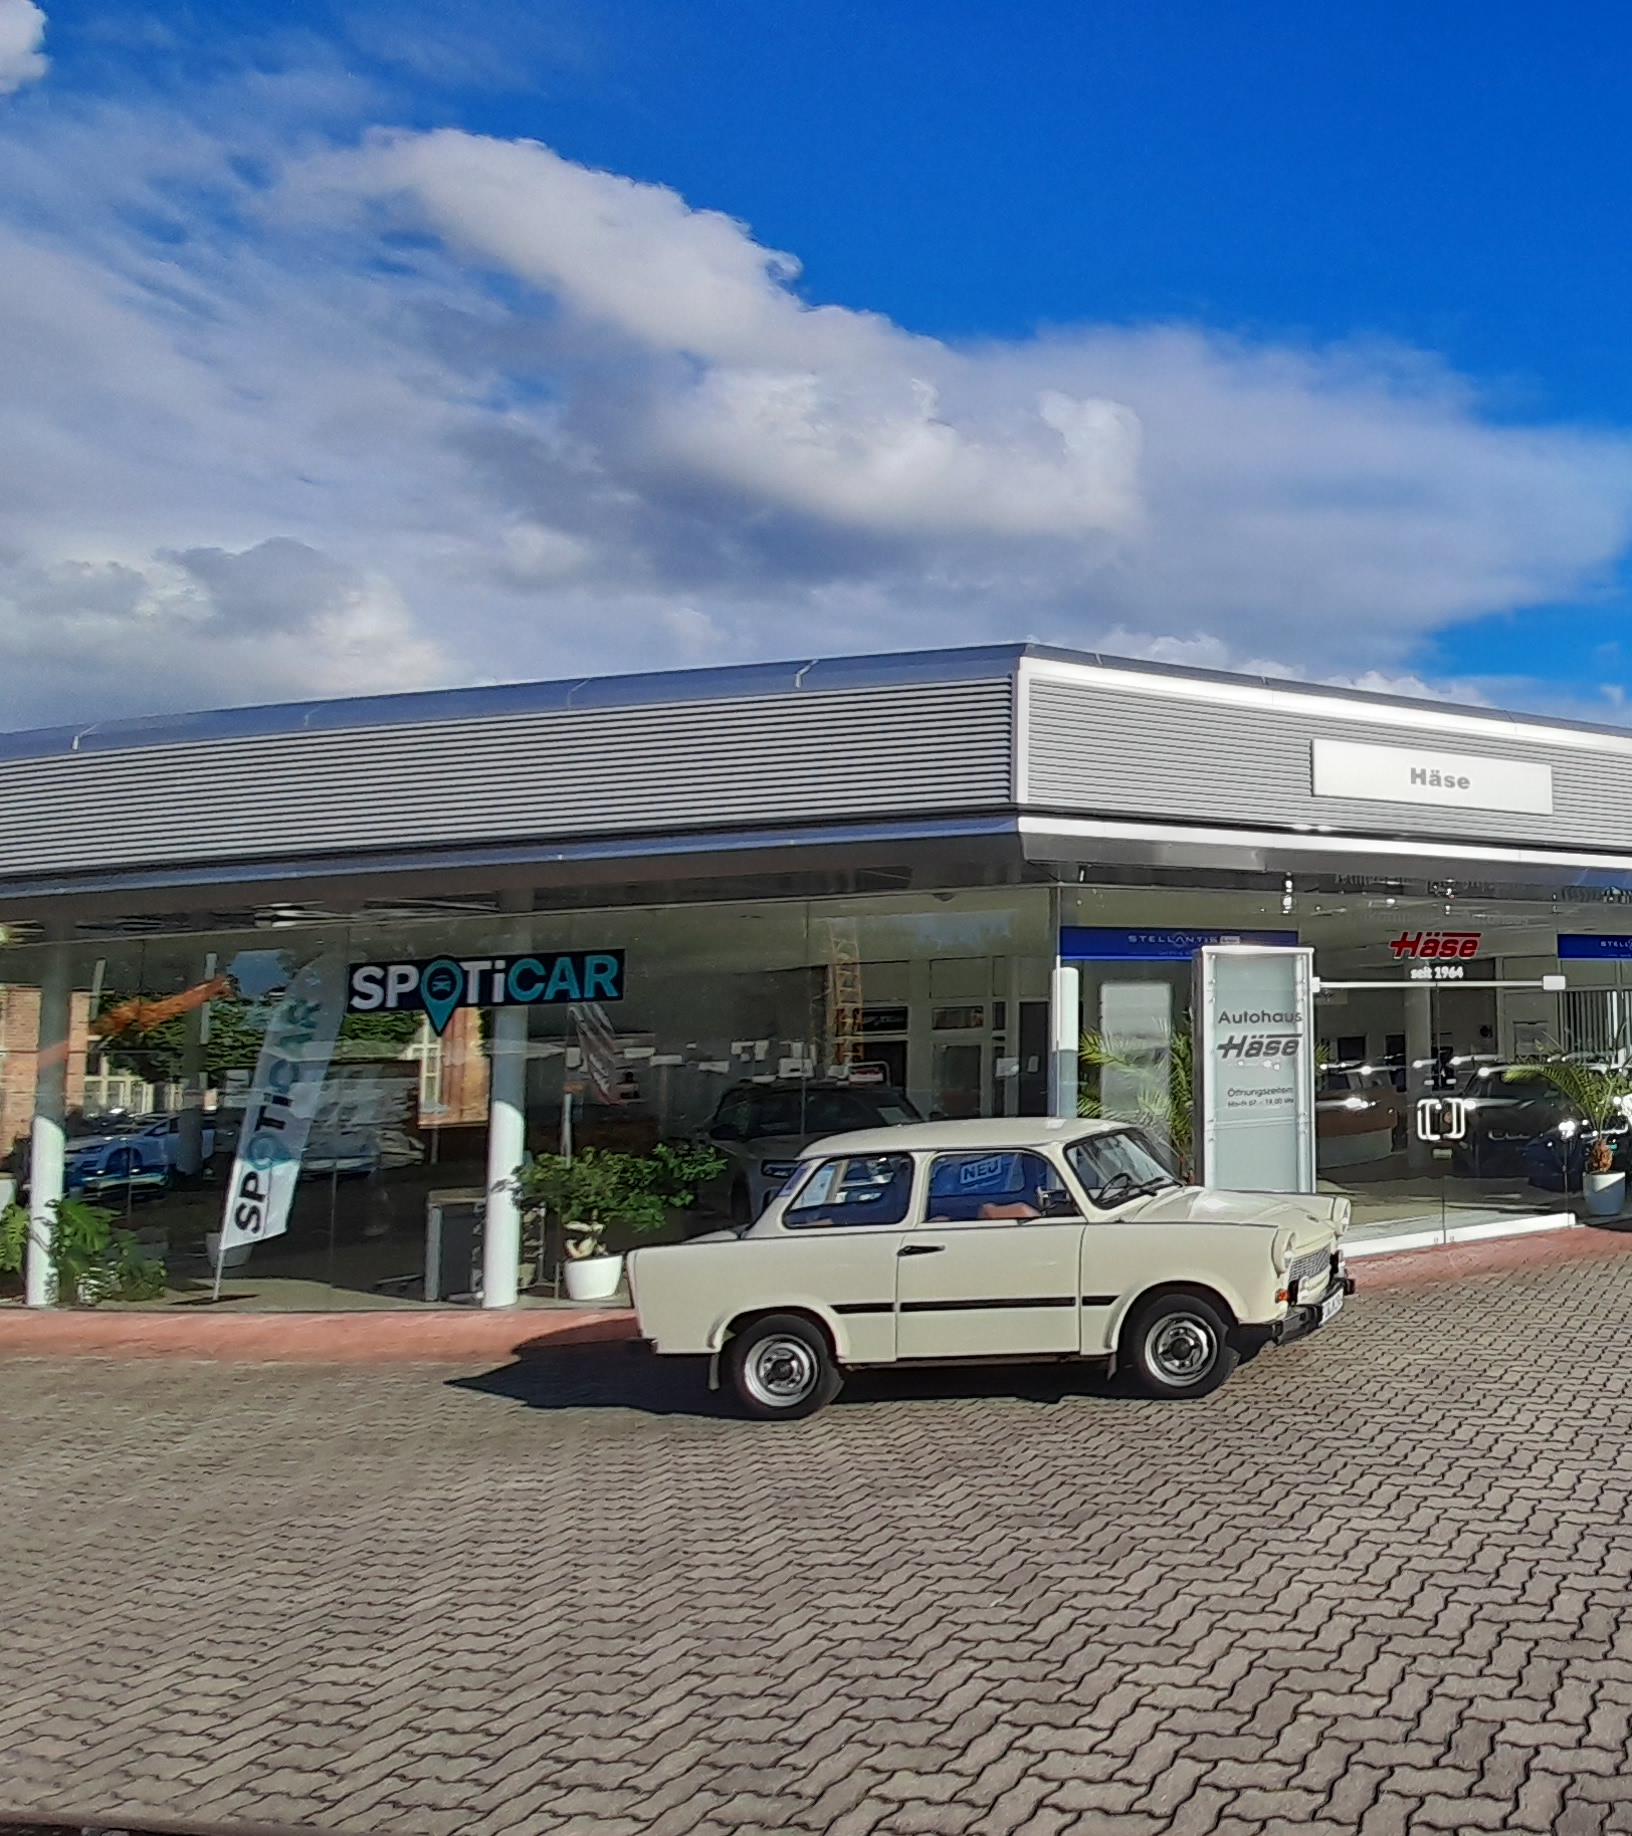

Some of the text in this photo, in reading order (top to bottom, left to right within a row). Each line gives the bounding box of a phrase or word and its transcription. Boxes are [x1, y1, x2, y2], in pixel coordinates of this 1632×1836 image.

[1410, 767, 1471, 789] Häse
[1128, 934, 1218, 946] STELLANTIS
[1389, 931, 1482, 959] Häse
[1410, 966, 1464, 978] seit 1964
[1218, 1010, 1303, 1024] Autohaus
[1216, 1033, 1303, 1059] Häse
[963, 1159, 999, 1180] NEU
